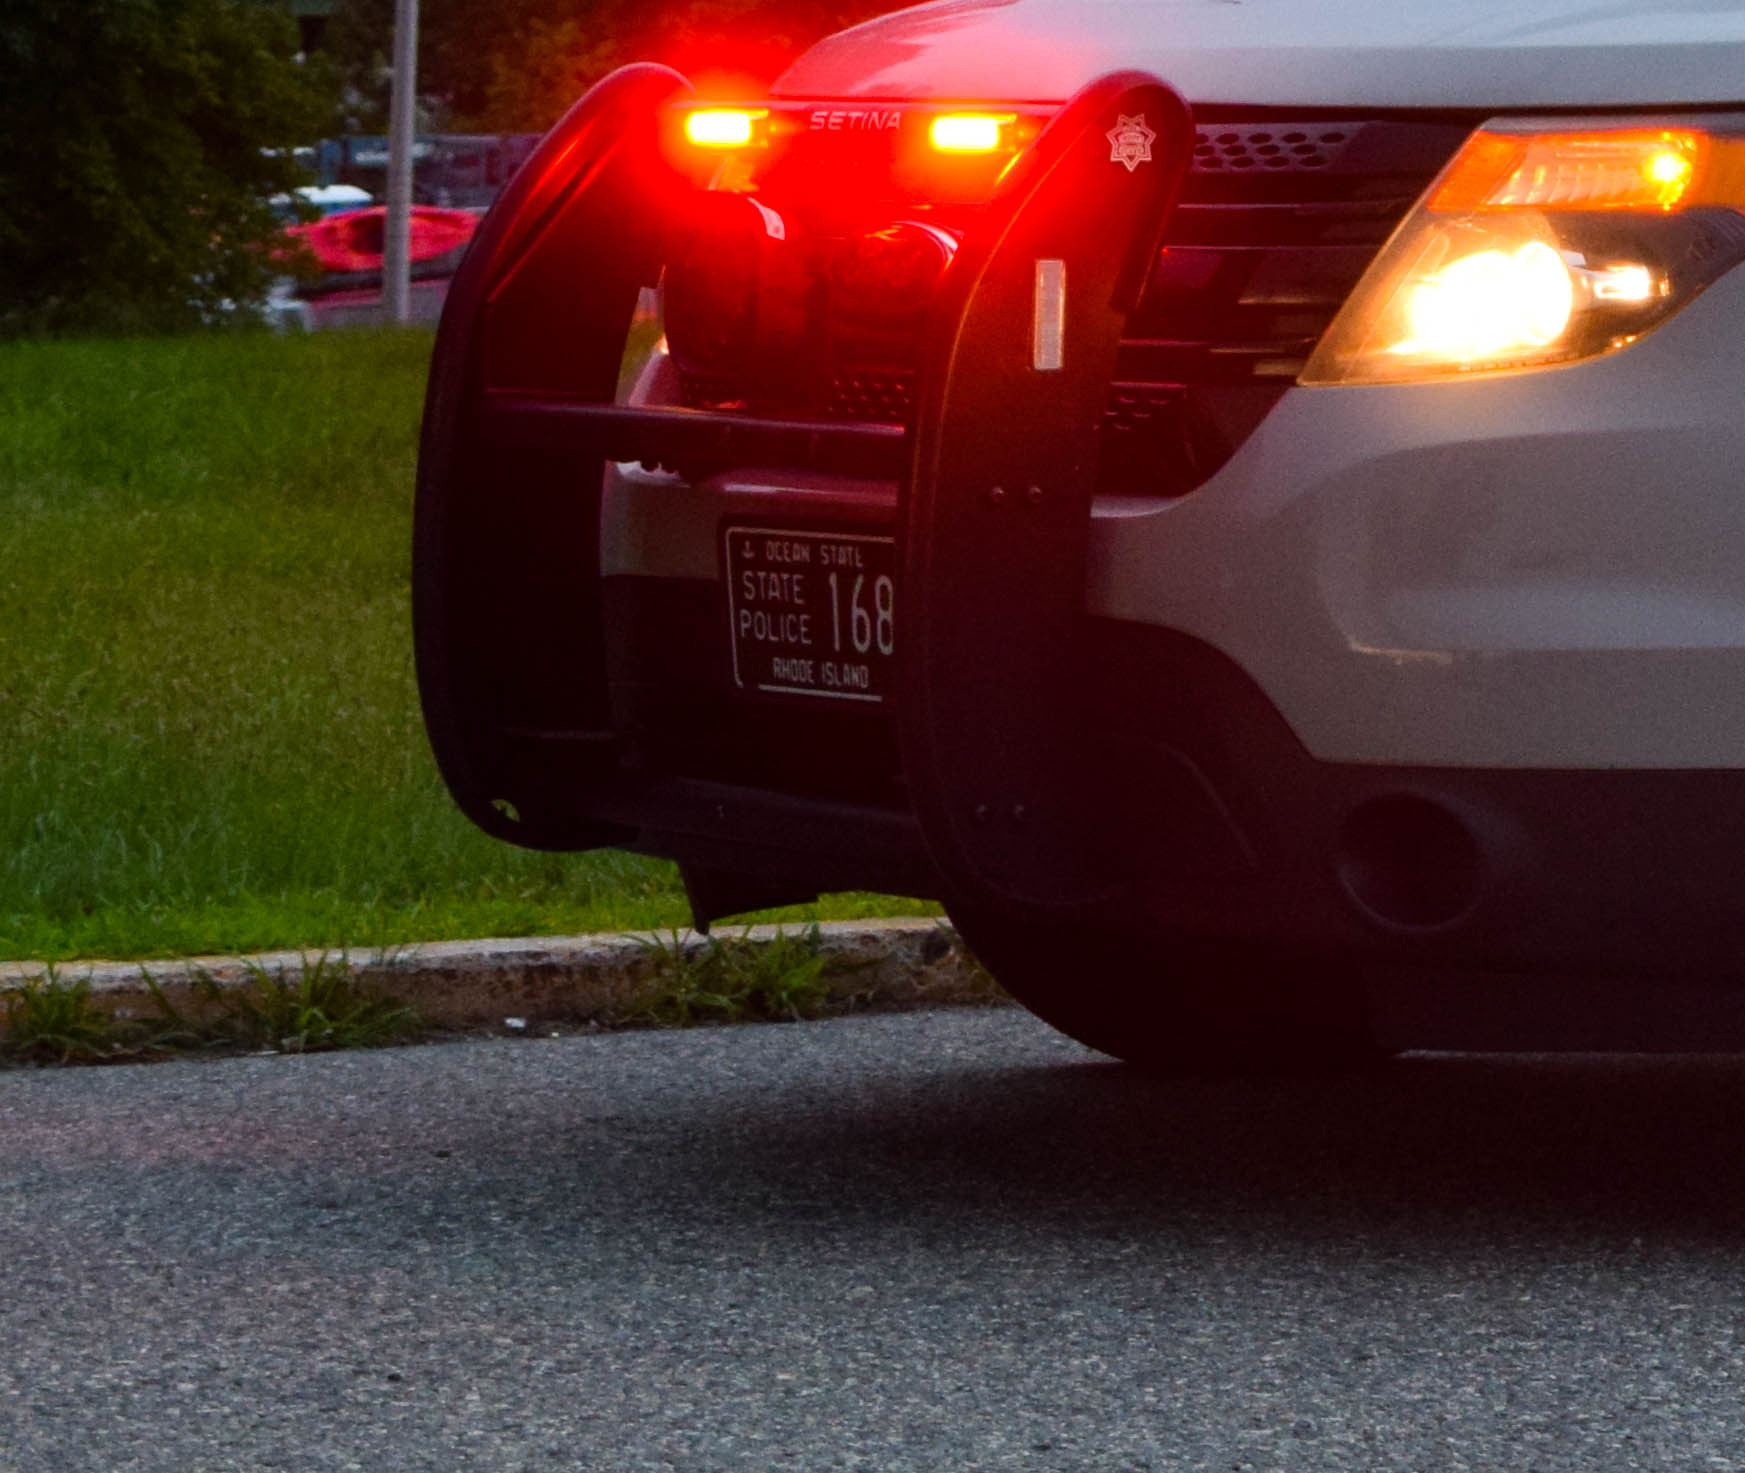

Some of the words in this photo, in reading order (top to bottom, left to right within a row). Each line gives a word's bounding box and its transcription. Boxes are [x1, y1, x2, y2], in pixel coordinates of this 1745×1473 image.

[810, 111, 901, 130] SETINA
[766, 540, 810, 563] OCEAN
[820, 544, 864, 567] STATE
[743, 570, 806, 605] STATE
[739, 608, 812, 645] POLICE
[829, 571, 894, 655] 168
[772, 656, 815, 682] RHODE
[822, 660, 869, 688] ISLAND
